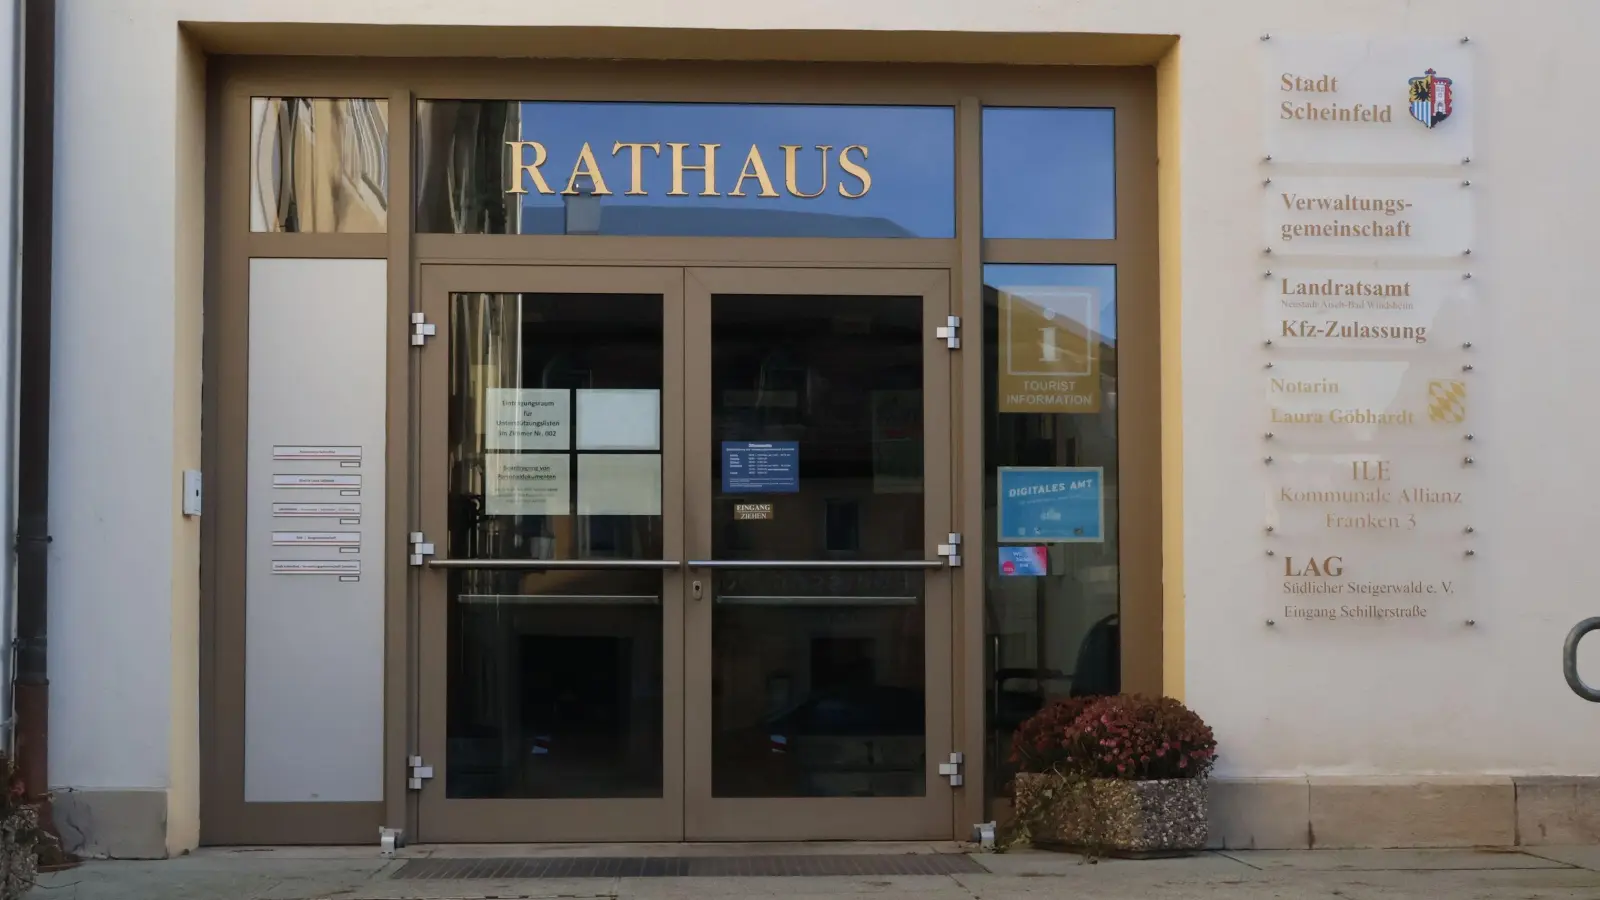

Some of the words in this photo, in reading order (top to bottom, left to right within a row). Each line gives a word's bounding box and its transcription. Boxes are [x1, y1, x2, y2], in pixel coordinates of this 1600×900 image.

[1280, 72, 1338, 92] Stadt
[1280, 100, 1392, 123] Scheinfeld
[504, 140, 872, 198] RATHAUS
[1281, 193, 1413, 216] Verwaltungs-
[1281, 219, 1412, 241] gemeinschaft
[1281, 278, 1411, 297] Landratsamt
[1281, 320, 1427, 344] Kfz-Zulassung
[1024, 381, 1077, 391] TOURIST
[1270, 378, 1340, 393] Notarin
[1007, 394, 1092, 405] INFORMATION
[1270, 408, 1324, 424] Laura
[1329, 408, 1414, 425] Göbhardt
[1351, 460, 1391, 481] ILE
[1008, 483, 1065, 497] DIGITALES
[1070, 479, 1093, 490] AMT
[1280, 486, 1391, 503] Kommunale
[1400, 487, 1462, 504] Allianz
[1326, 513, 1400, 529] Franken
[1407, 514, 1417, 530] 3
[1284, 556, 1343, 577] LAG
[1283, 581, 1344, 594] Südlicher
[1347, 581, 1422, 597] Steigerwald
[1426, 585, 1437, 594] e.
[1442, 581, 1454, 594] V.
[1284, 605, 1337, 620] Eingang
[1340, 605, 1427, 618] Schillerstraße
